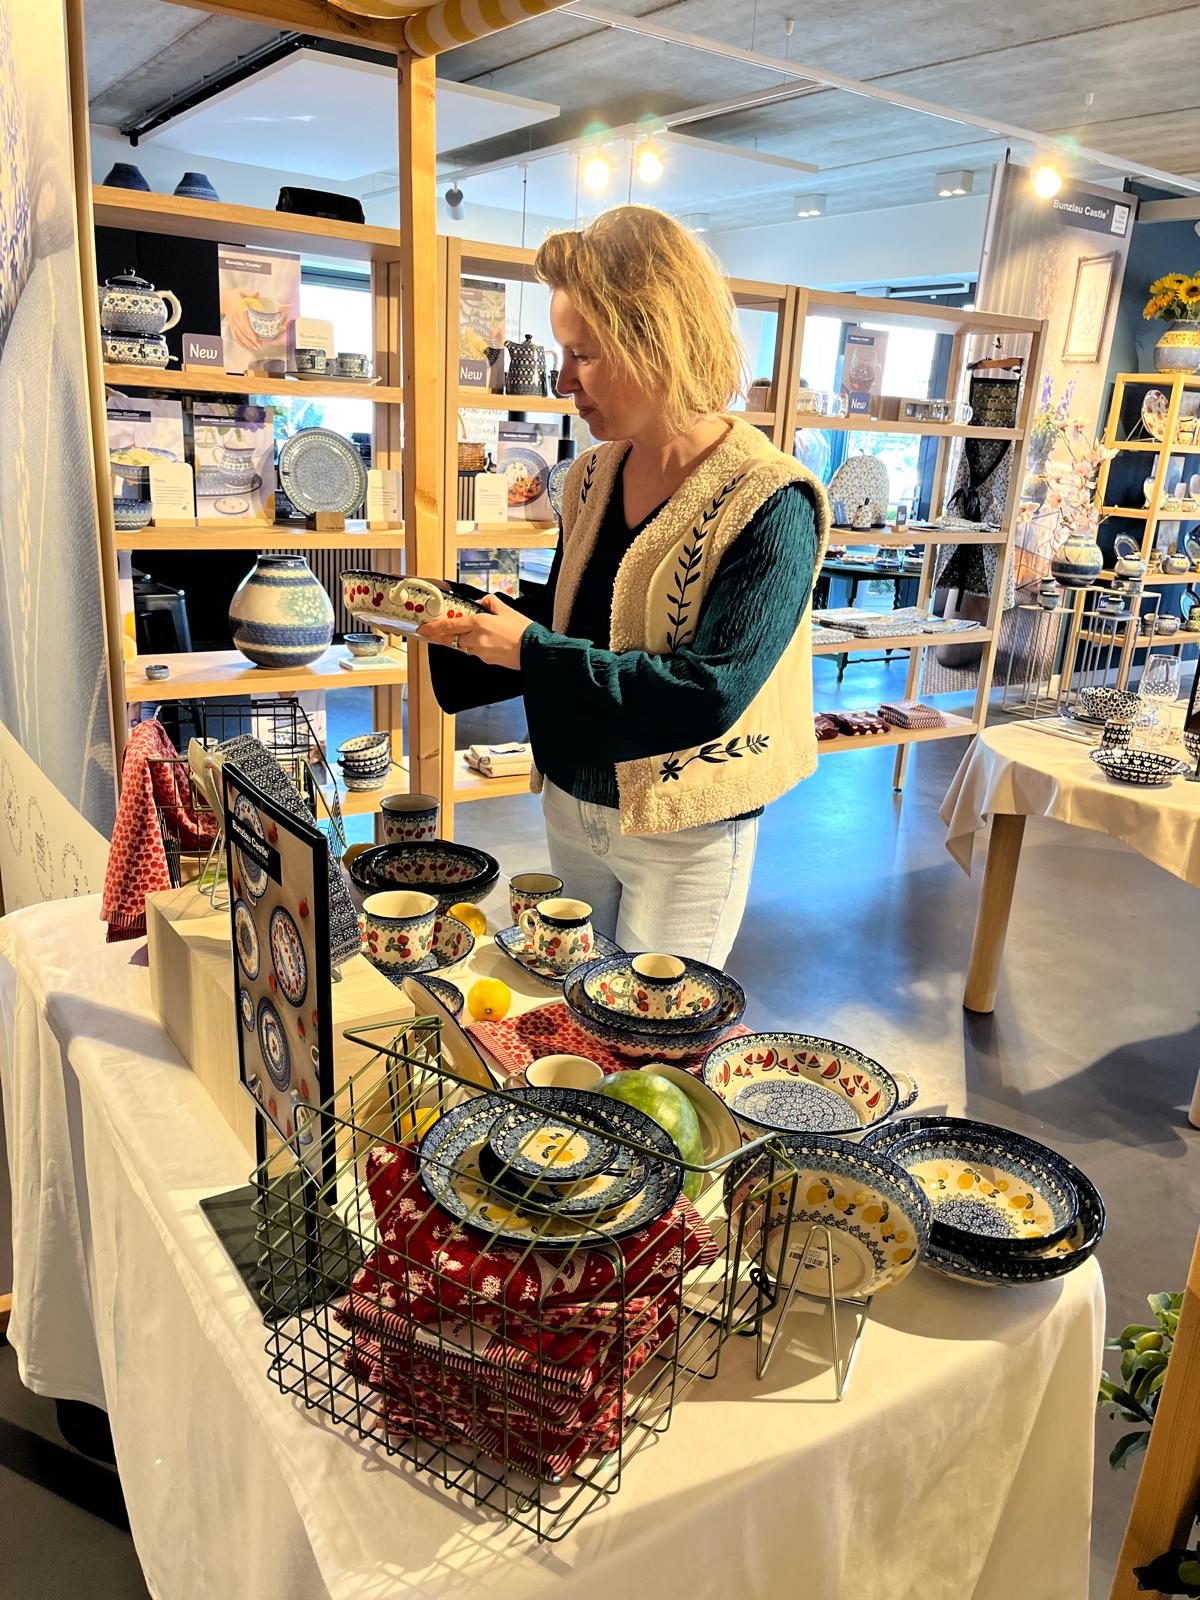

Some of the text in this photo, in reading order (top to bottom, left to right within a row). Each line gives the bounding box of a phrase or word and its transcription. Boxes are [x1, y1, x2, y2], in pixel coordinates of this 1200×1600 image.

[1053, 200, 1084, 214] Bunzlau
[190, 343, 218, 359] New
[460, 366, 483, 381] New
[851, 399, 867, 409] New
